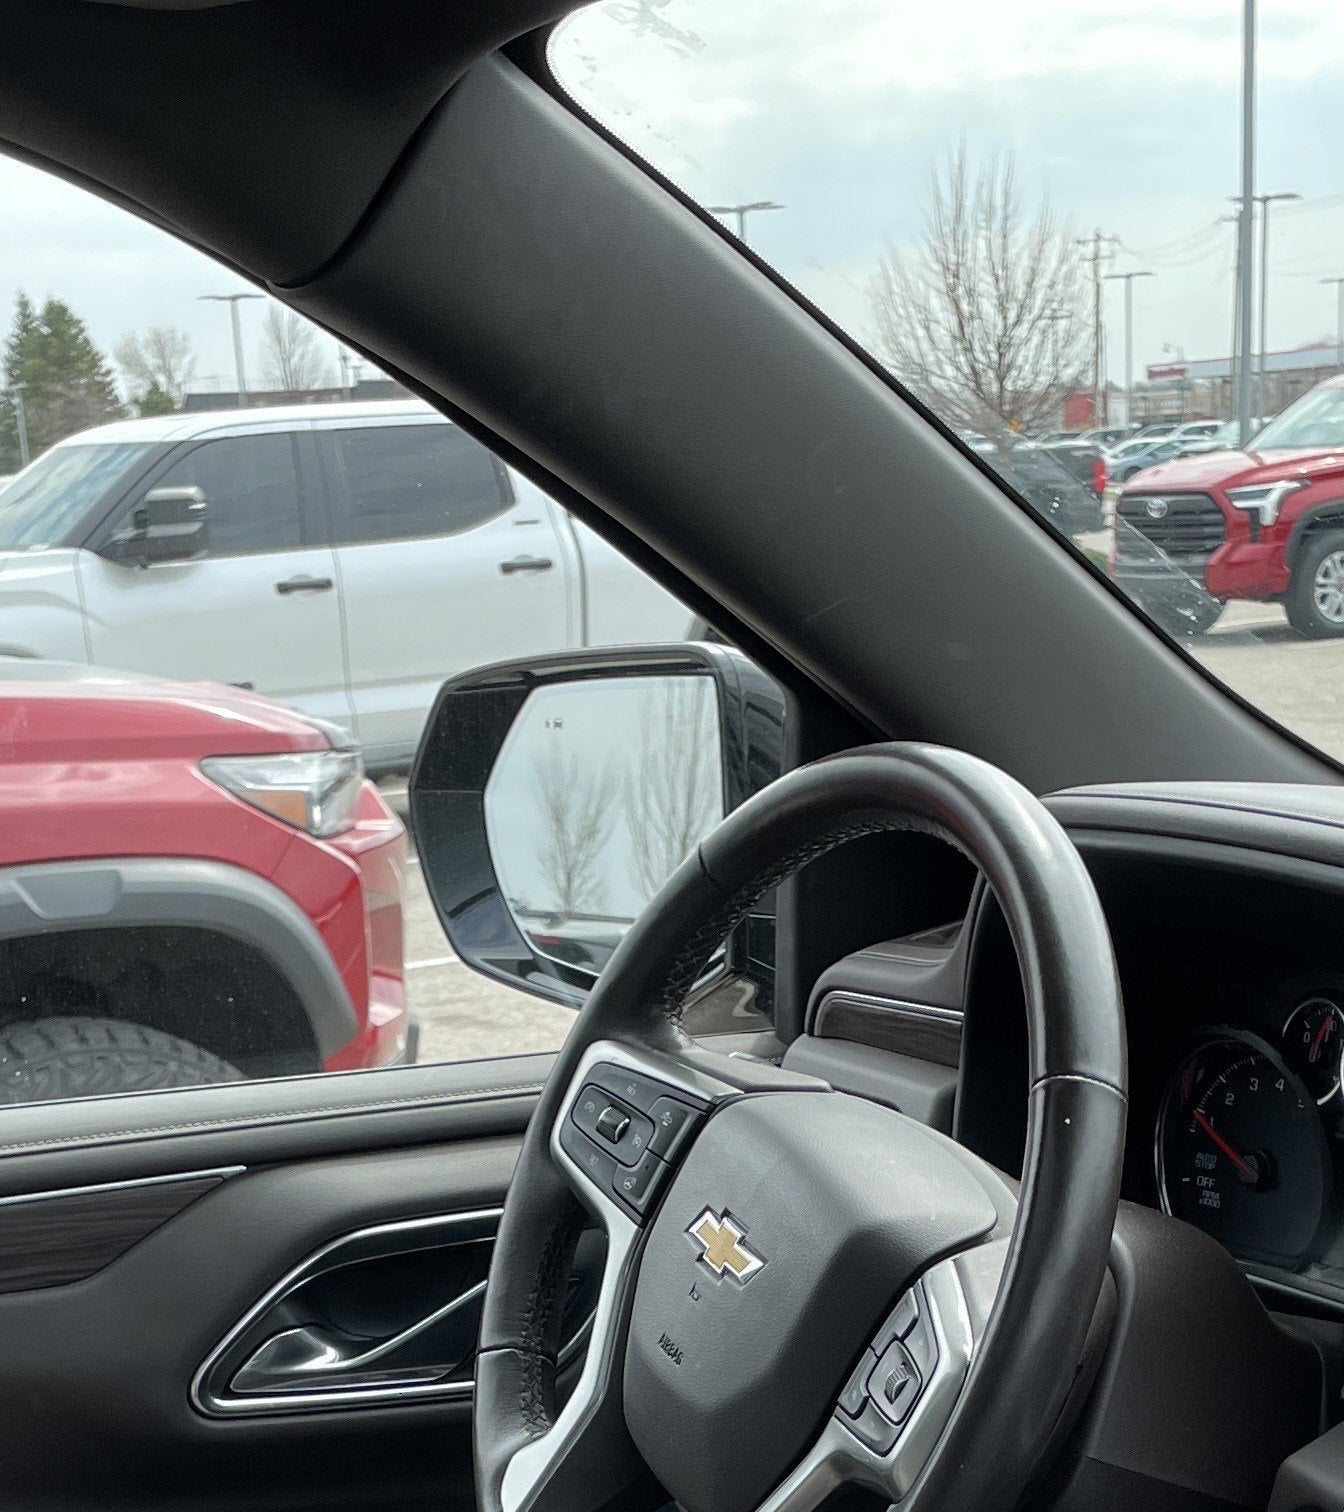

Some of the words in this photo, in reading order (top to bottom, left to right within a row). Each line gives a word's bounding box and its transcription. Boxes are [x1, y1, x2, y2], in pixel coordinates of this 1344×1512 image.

[1249, 1077, 1259, 1091] 3
[1275, 1078, 1285, 1091] 4
[1224, 1092, 1235, 1106] 2
[1196, 1175, 1216, 1188] OFF
